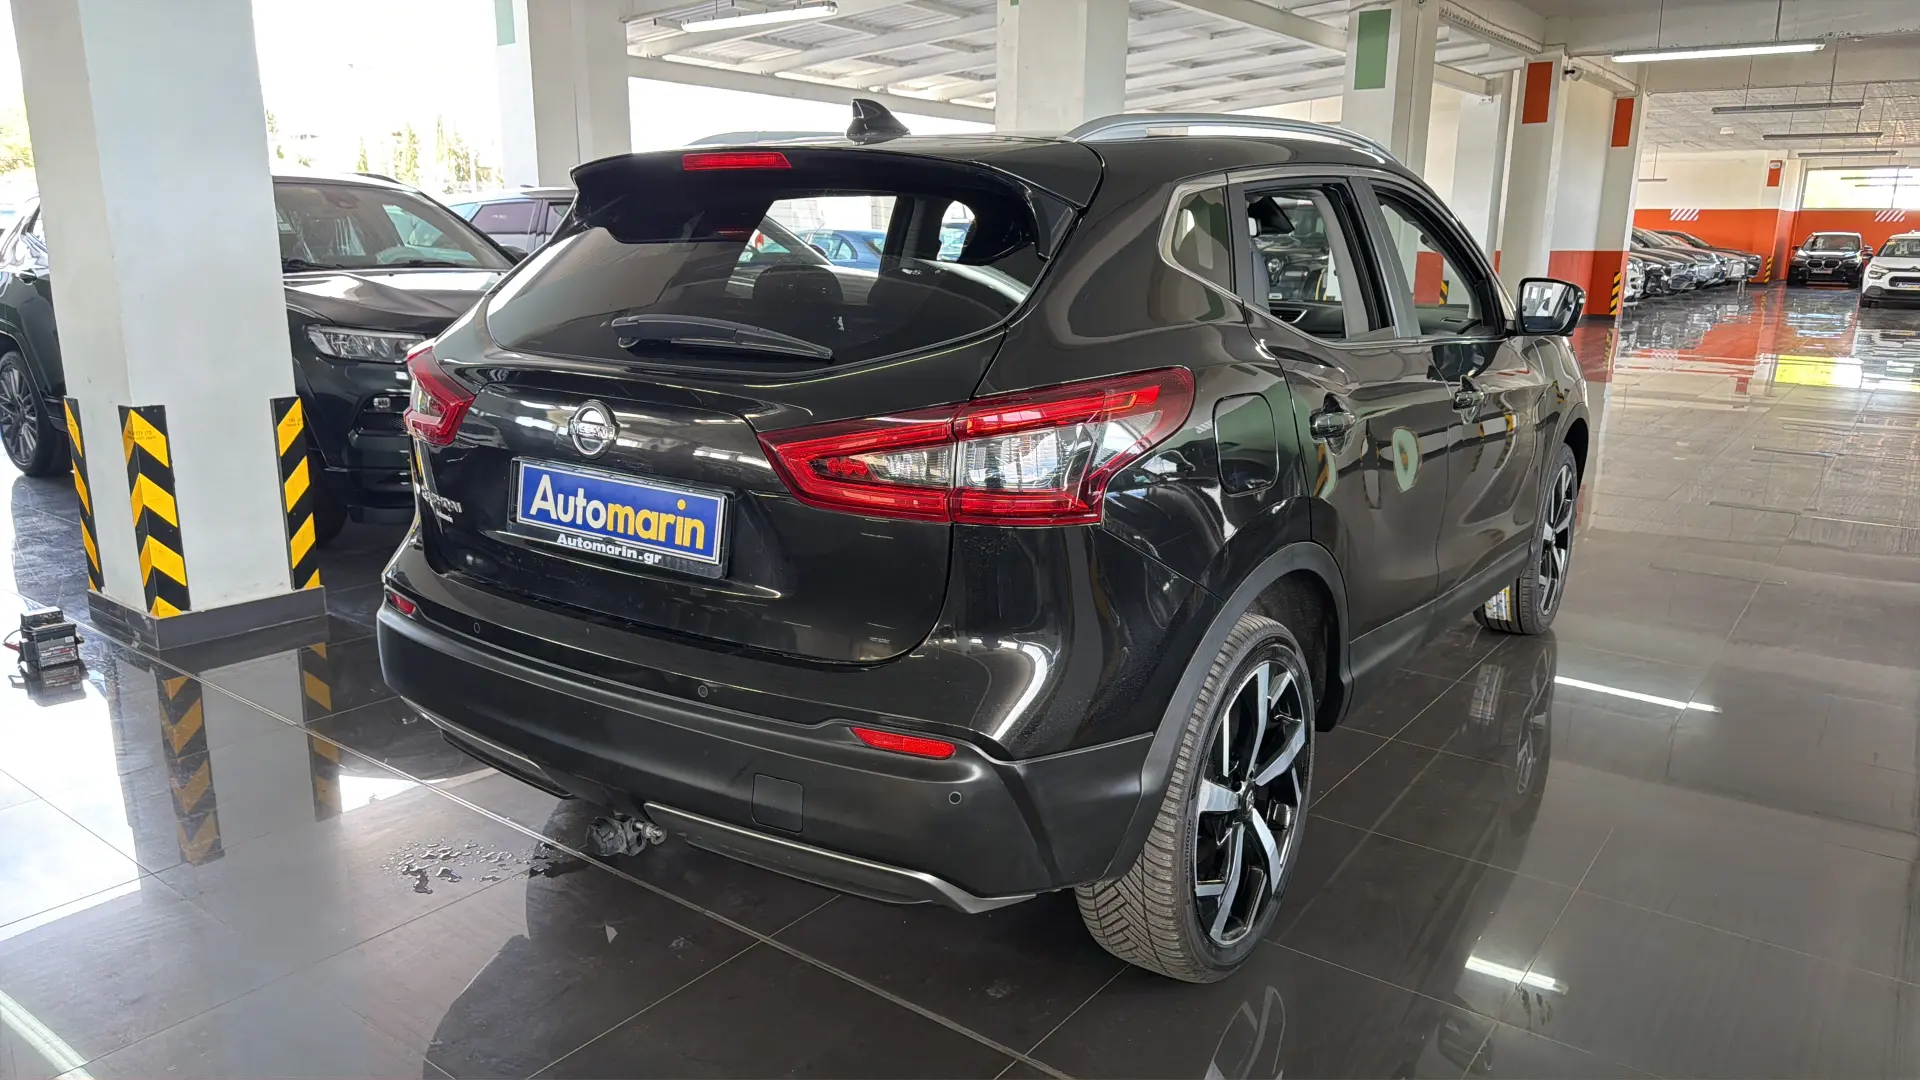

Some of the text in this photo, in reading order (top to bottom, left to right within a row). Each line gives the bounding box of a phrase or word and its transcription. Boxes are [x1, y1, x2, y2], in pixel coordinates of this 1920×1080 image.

[573, 420, 609, 440] NISSAN
[529, 474, 705, 550] Automarin
[556, 533, 662, 564] Automarin.gr
